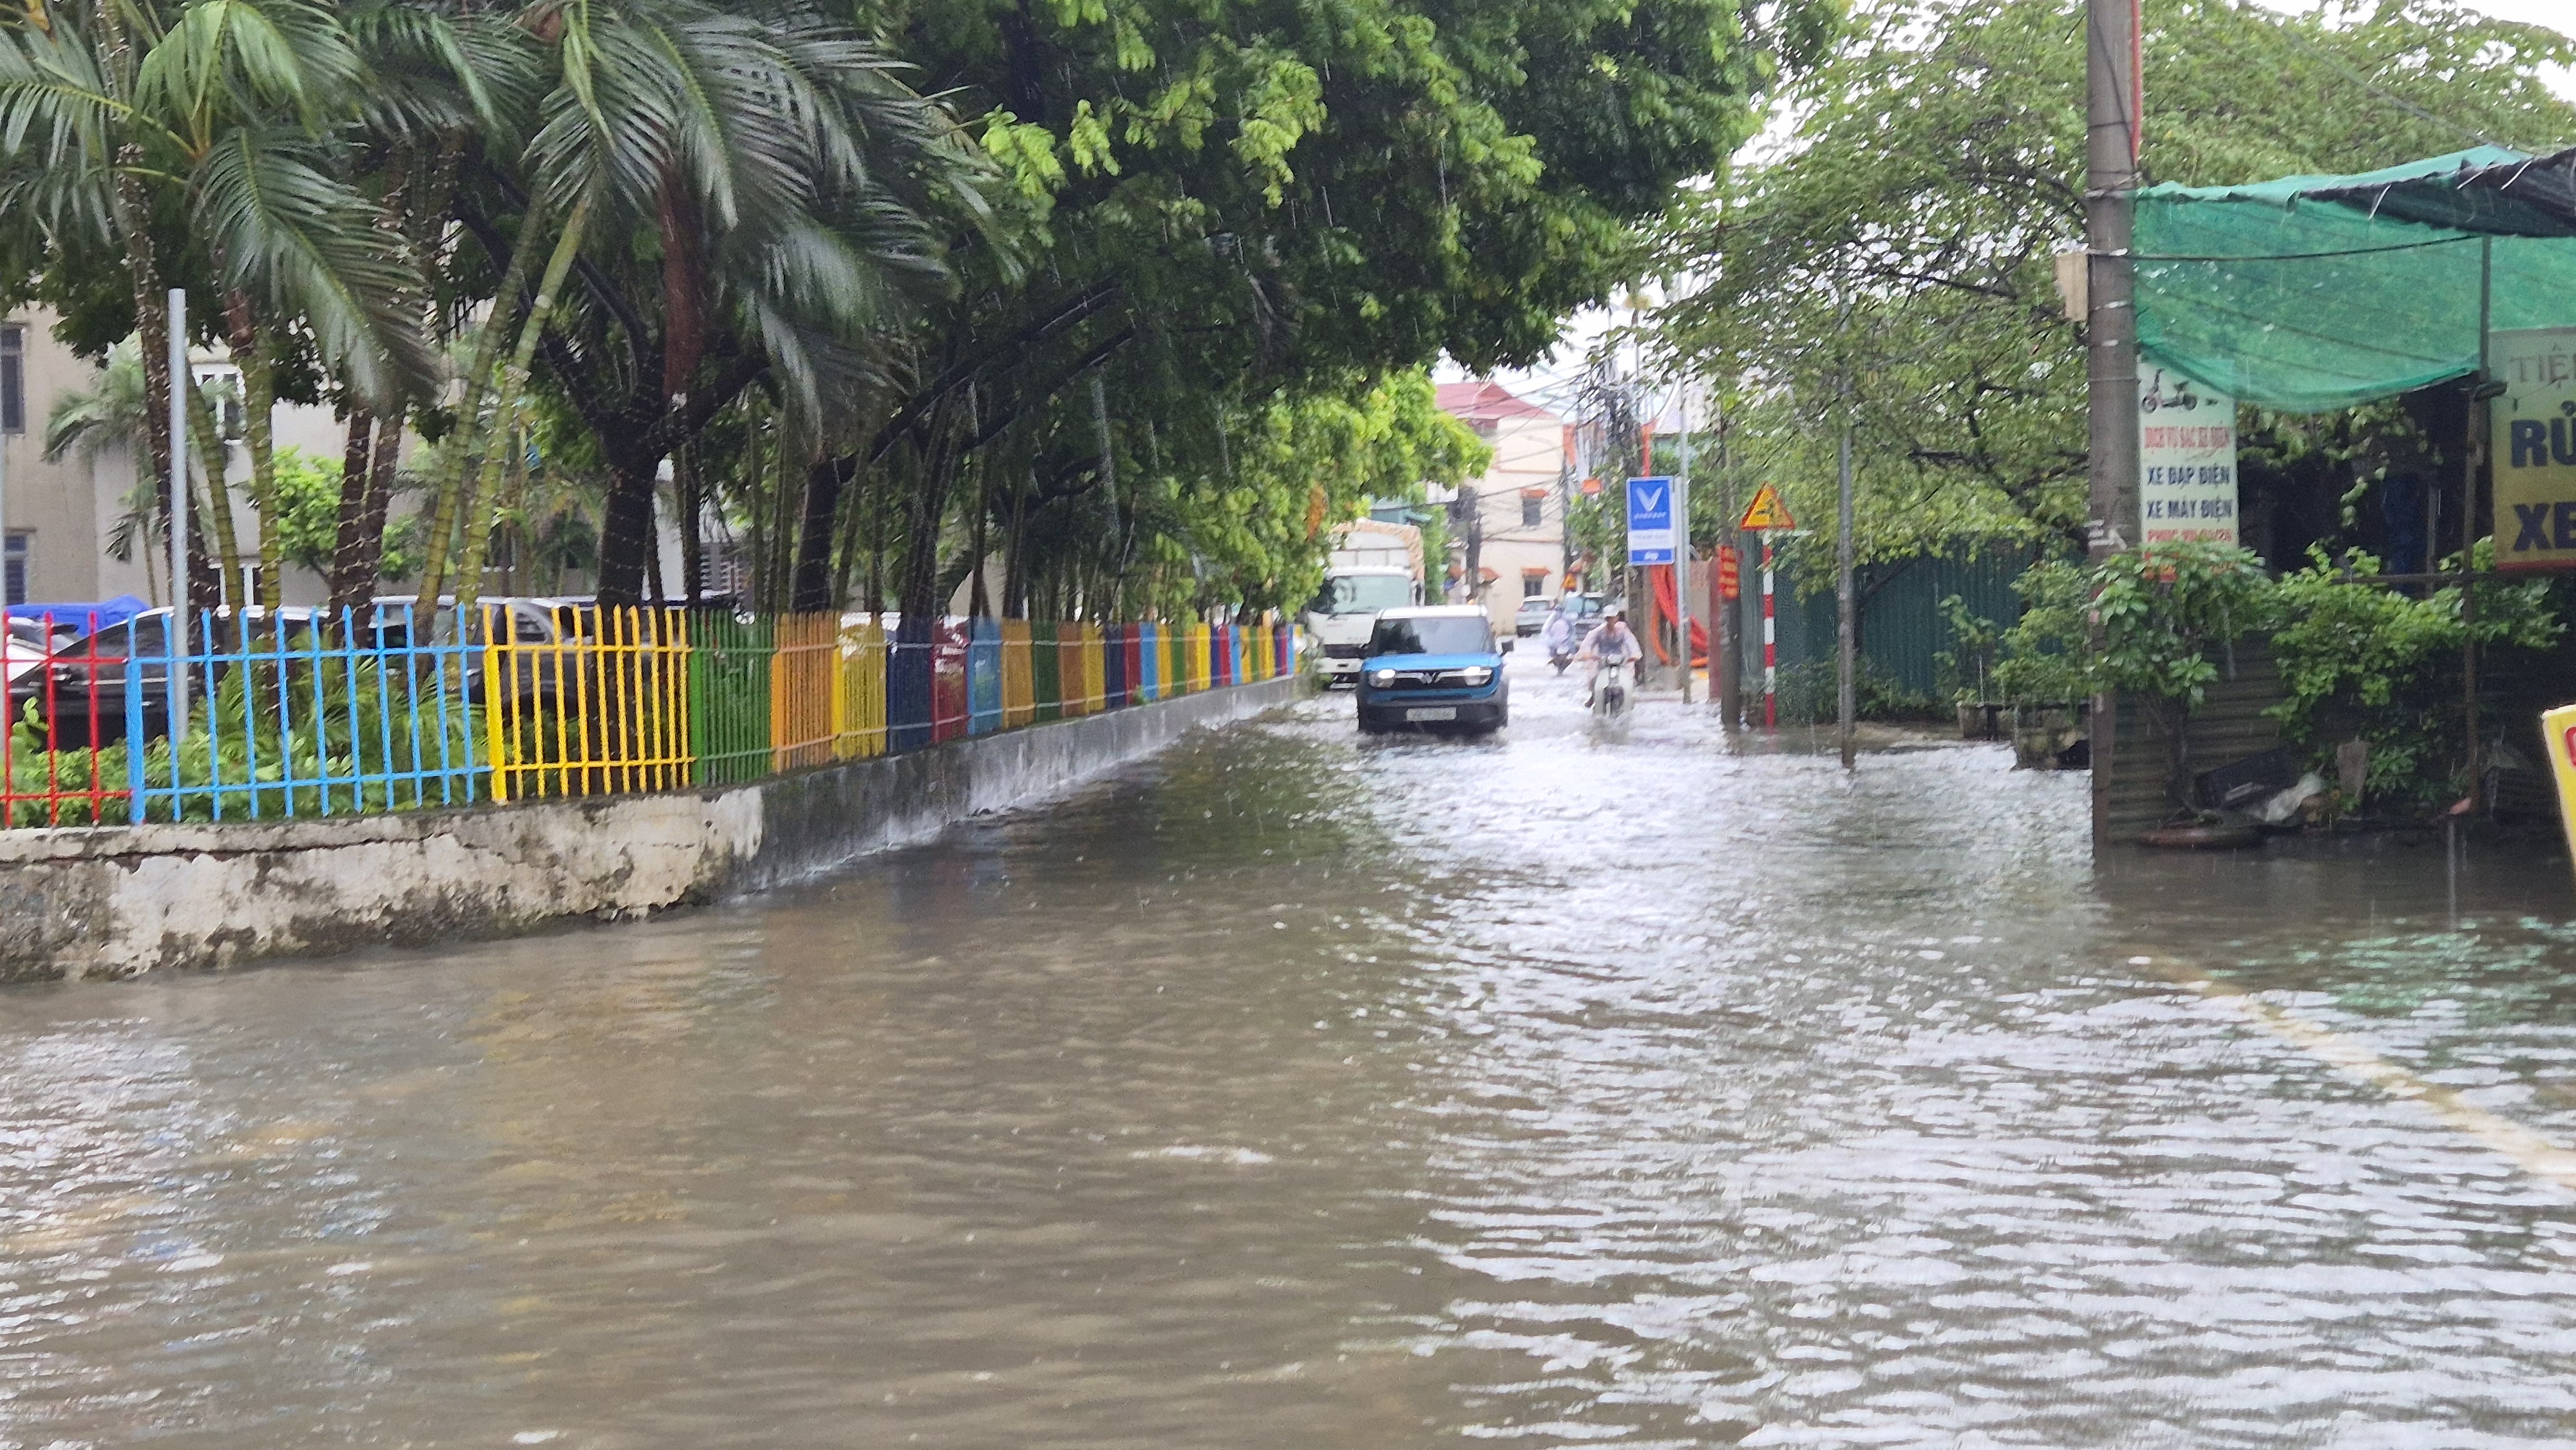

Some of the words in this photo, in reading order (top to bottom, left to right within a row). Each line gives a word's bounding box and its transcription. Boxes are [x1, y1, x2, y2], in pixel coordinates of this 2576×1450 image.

[2510, 343, 2576, 389] TIỆ
[2147, 467, 2163, 485] XE
[2199, 462, 2230, 488] ĐIỆN
[2147, 500, 2163, 518] XE
[2168, 496, 2197, 518] MÁY
[2201, 495, 2233, 522] ĐIỆN
